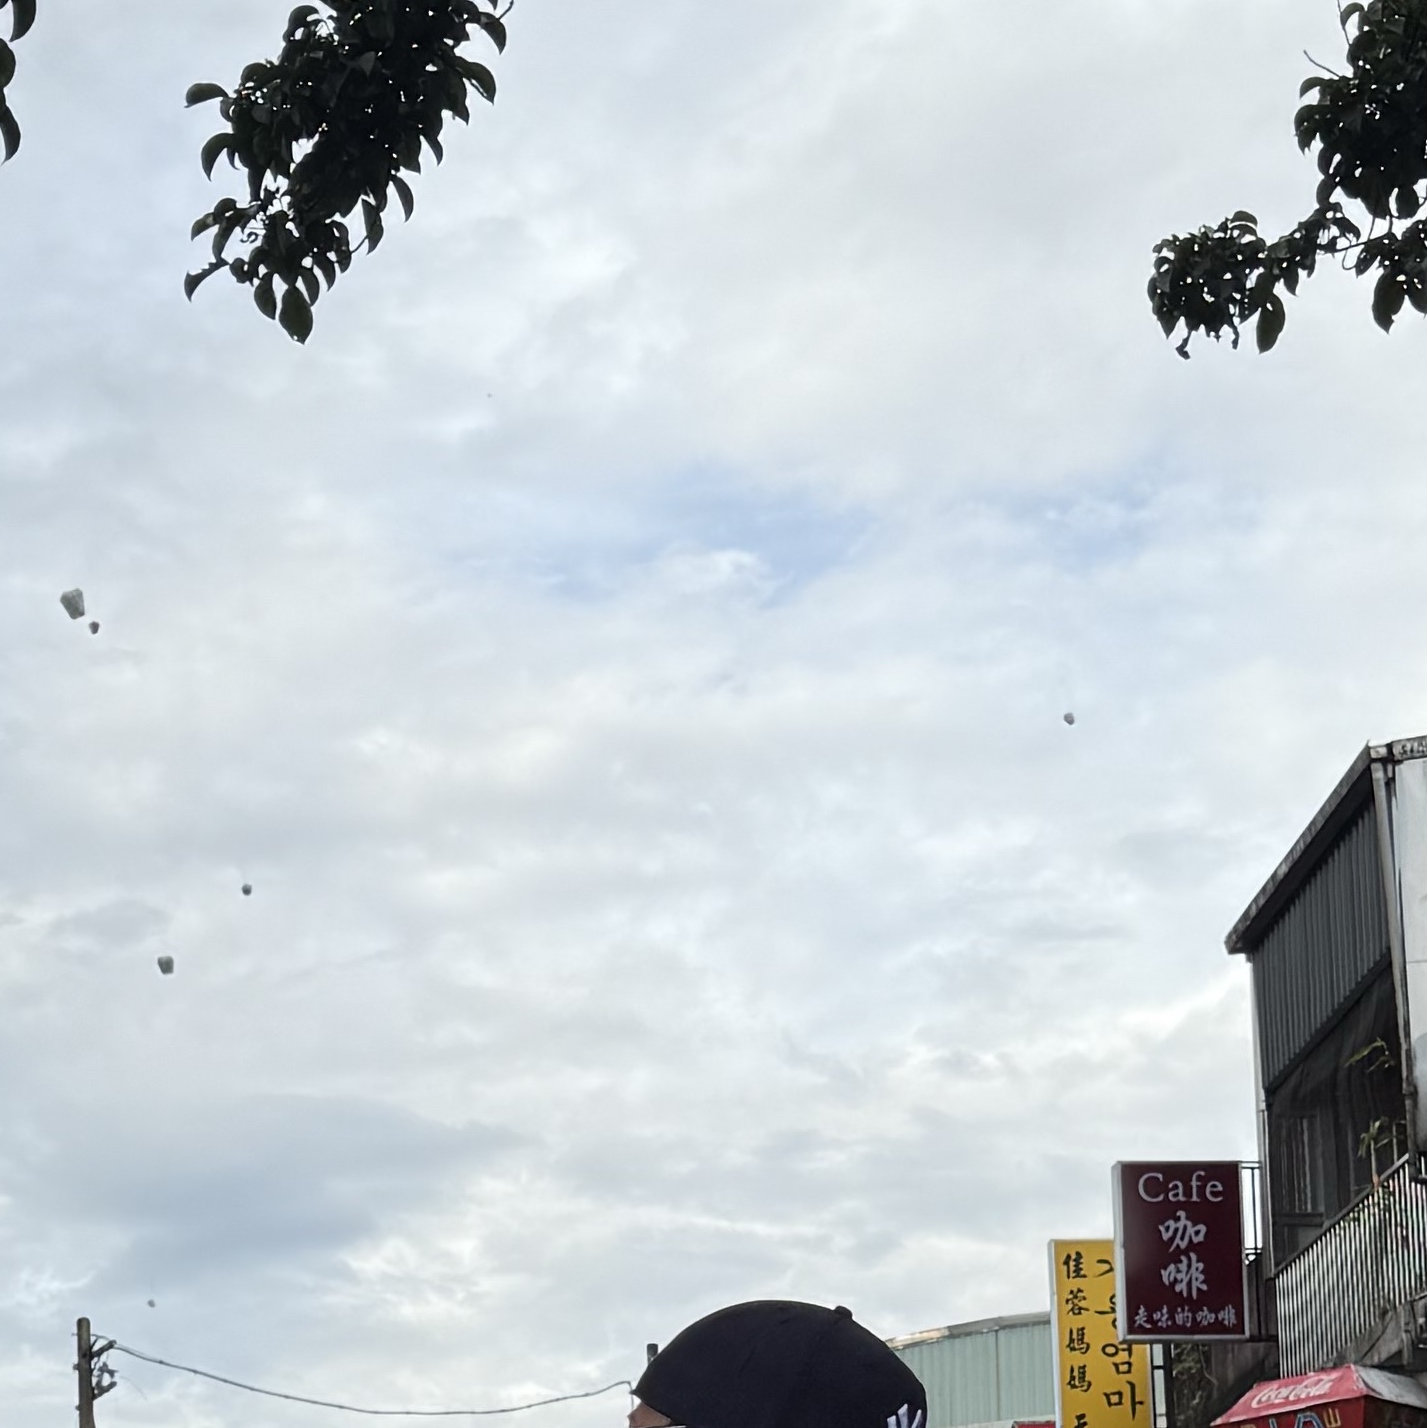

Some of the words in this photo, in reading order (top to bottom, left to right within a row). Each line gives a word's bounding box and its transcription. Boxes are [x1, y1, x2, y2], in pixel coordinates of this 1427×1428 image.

[1137, 1171, 1224, 1203] Cafe
[1158, 1210, 1209, 1300] 咖啡
[1133, 1305, 1238, 1329] 走味的咖啡
